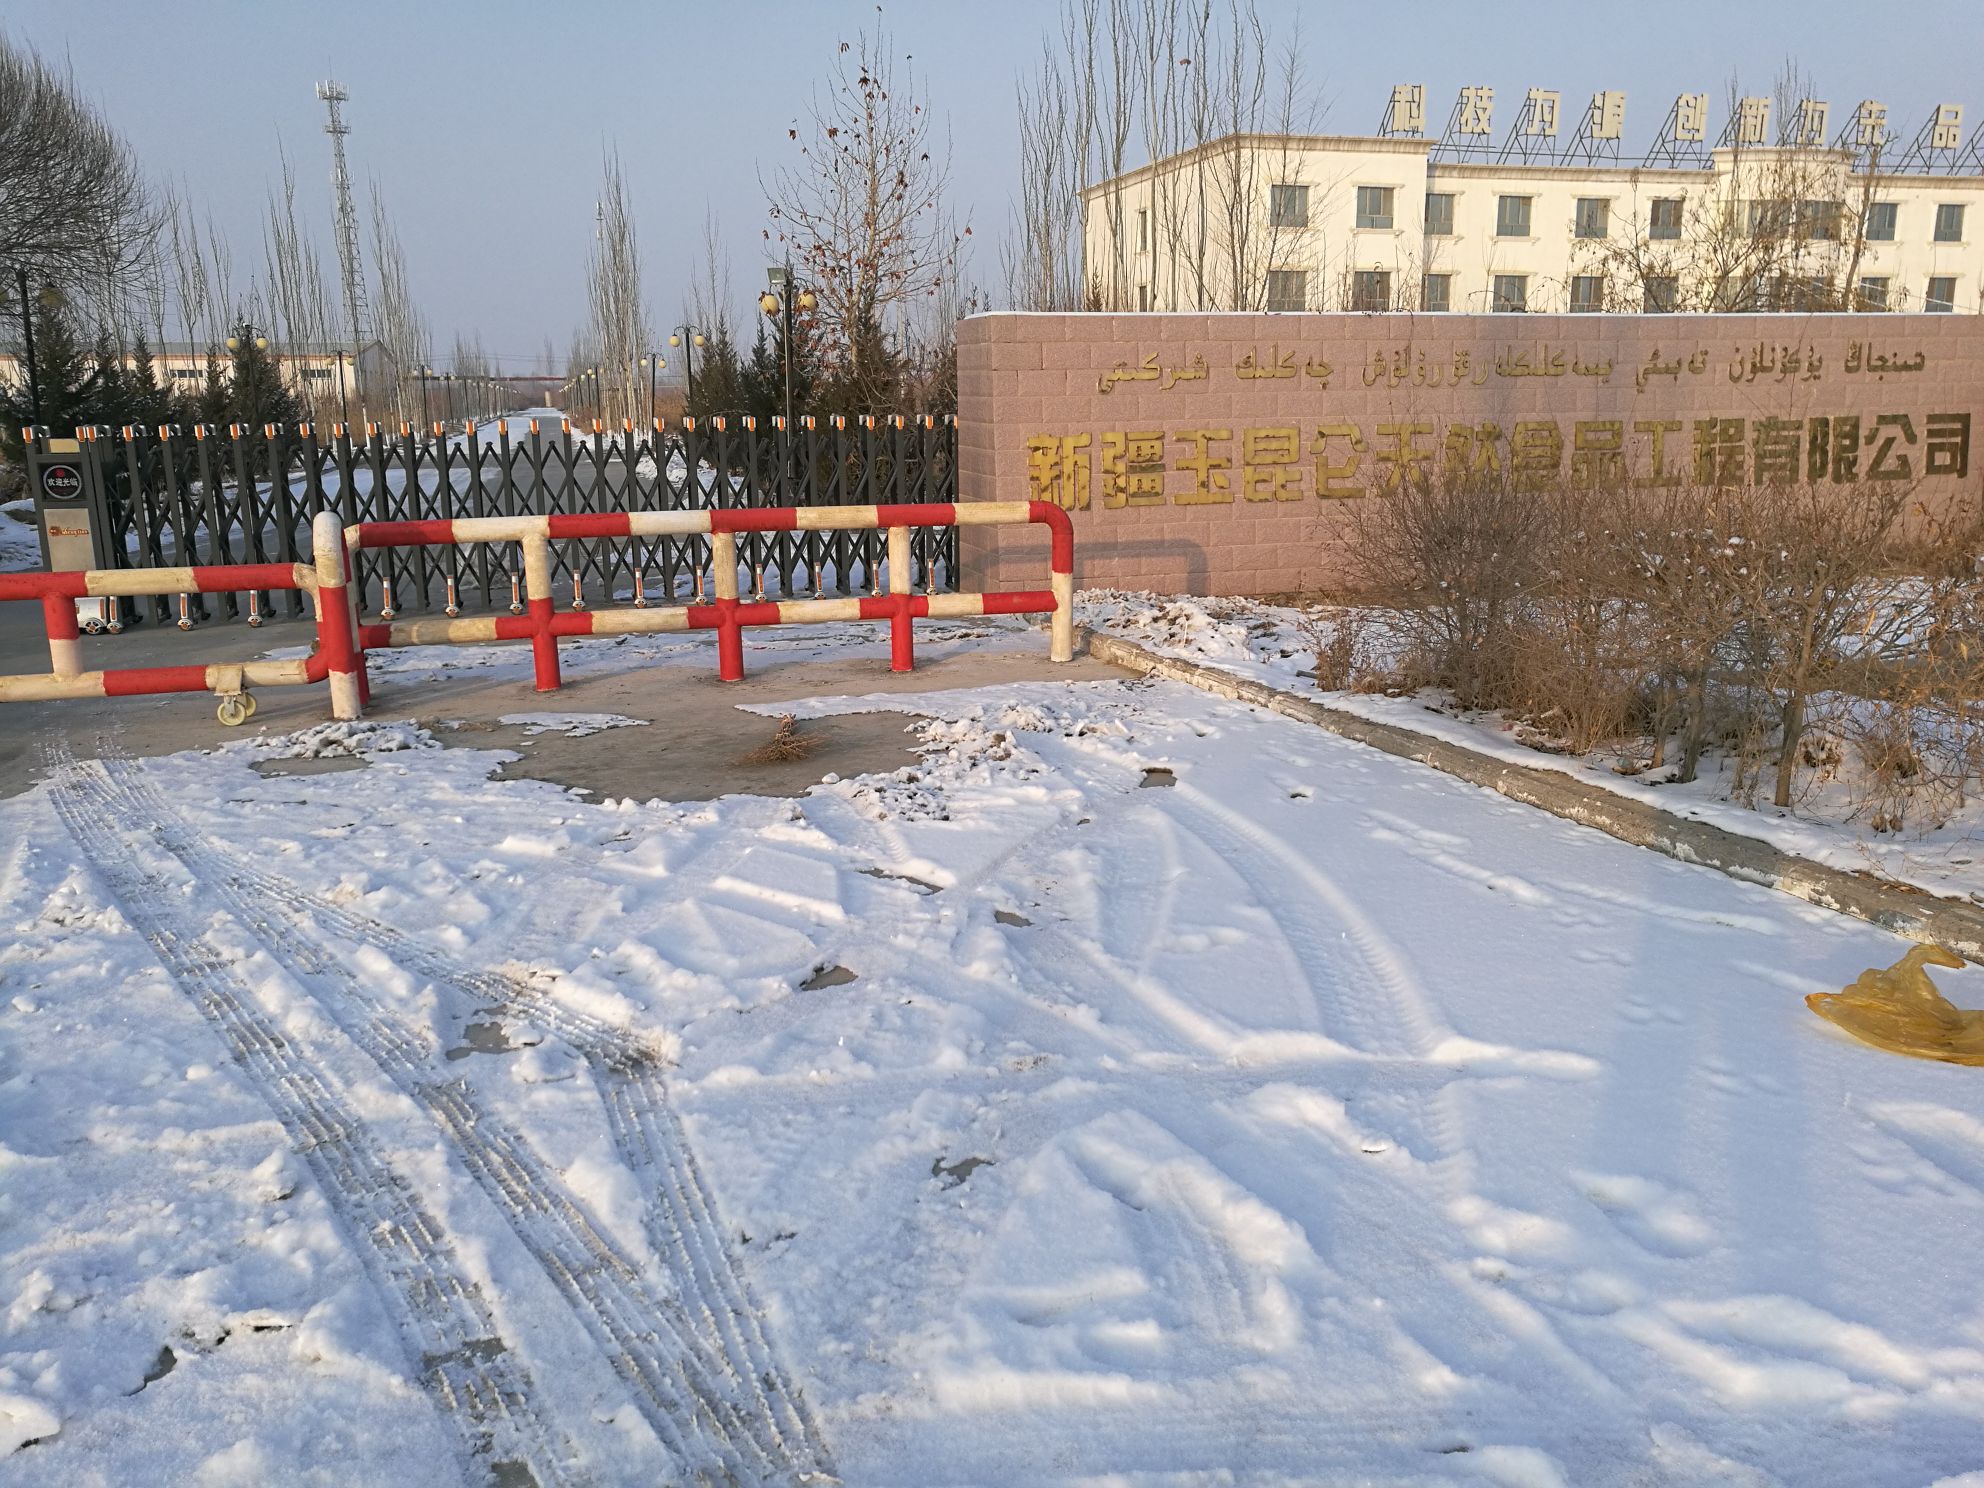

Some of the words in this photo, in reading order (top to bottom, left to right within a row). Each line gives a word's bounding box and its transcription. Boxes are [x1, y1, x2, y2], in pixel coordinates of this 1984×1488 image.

[1932, 103, 1965, 149] 品
[47, 477, 79, 487] 欢迎光临
